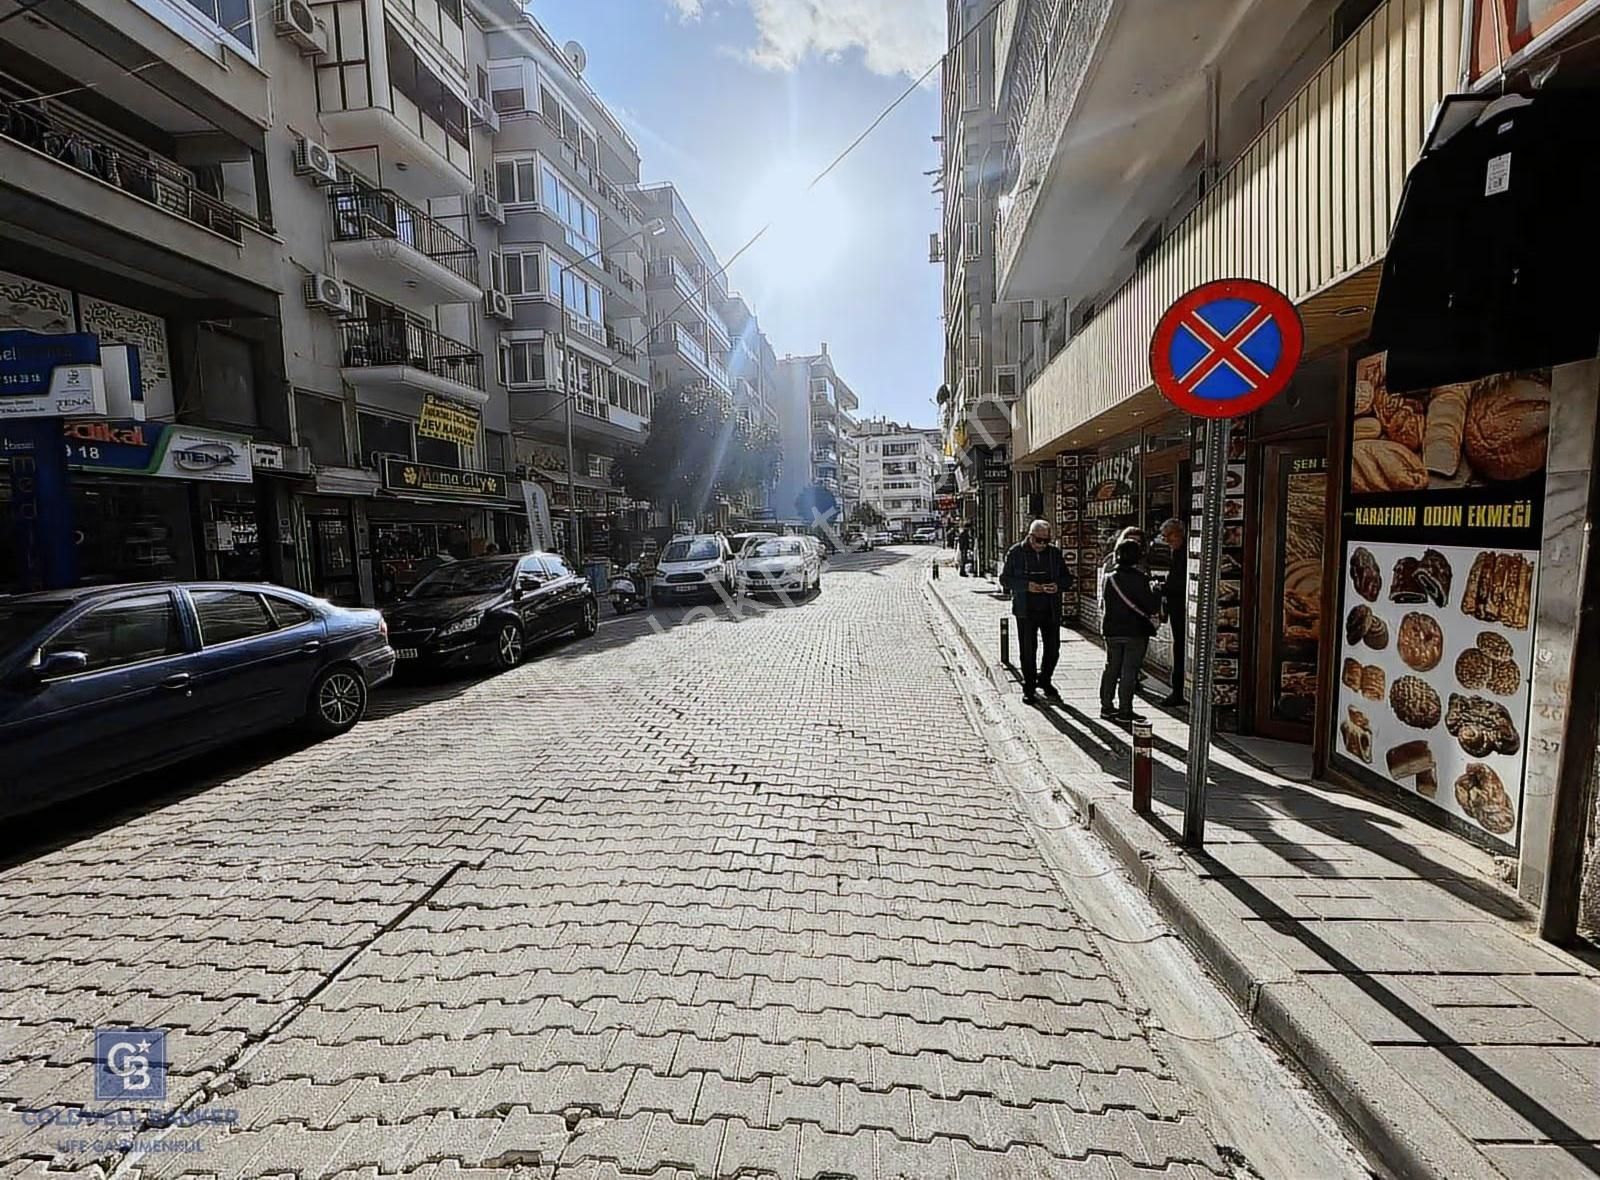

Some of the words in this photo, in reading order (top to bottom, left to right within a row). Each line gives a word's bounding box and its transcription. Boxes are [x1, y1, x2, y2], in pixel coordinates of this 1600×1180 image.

[56, 399, 91, 411] TENA
[78, 445, 101, 460] 18
[1355, 506, 1416, 526] KARAFIRIN
[1423, 505, 1462, 527] ODUN
[1468, 499, 1532, 528] EKMEĞİ
